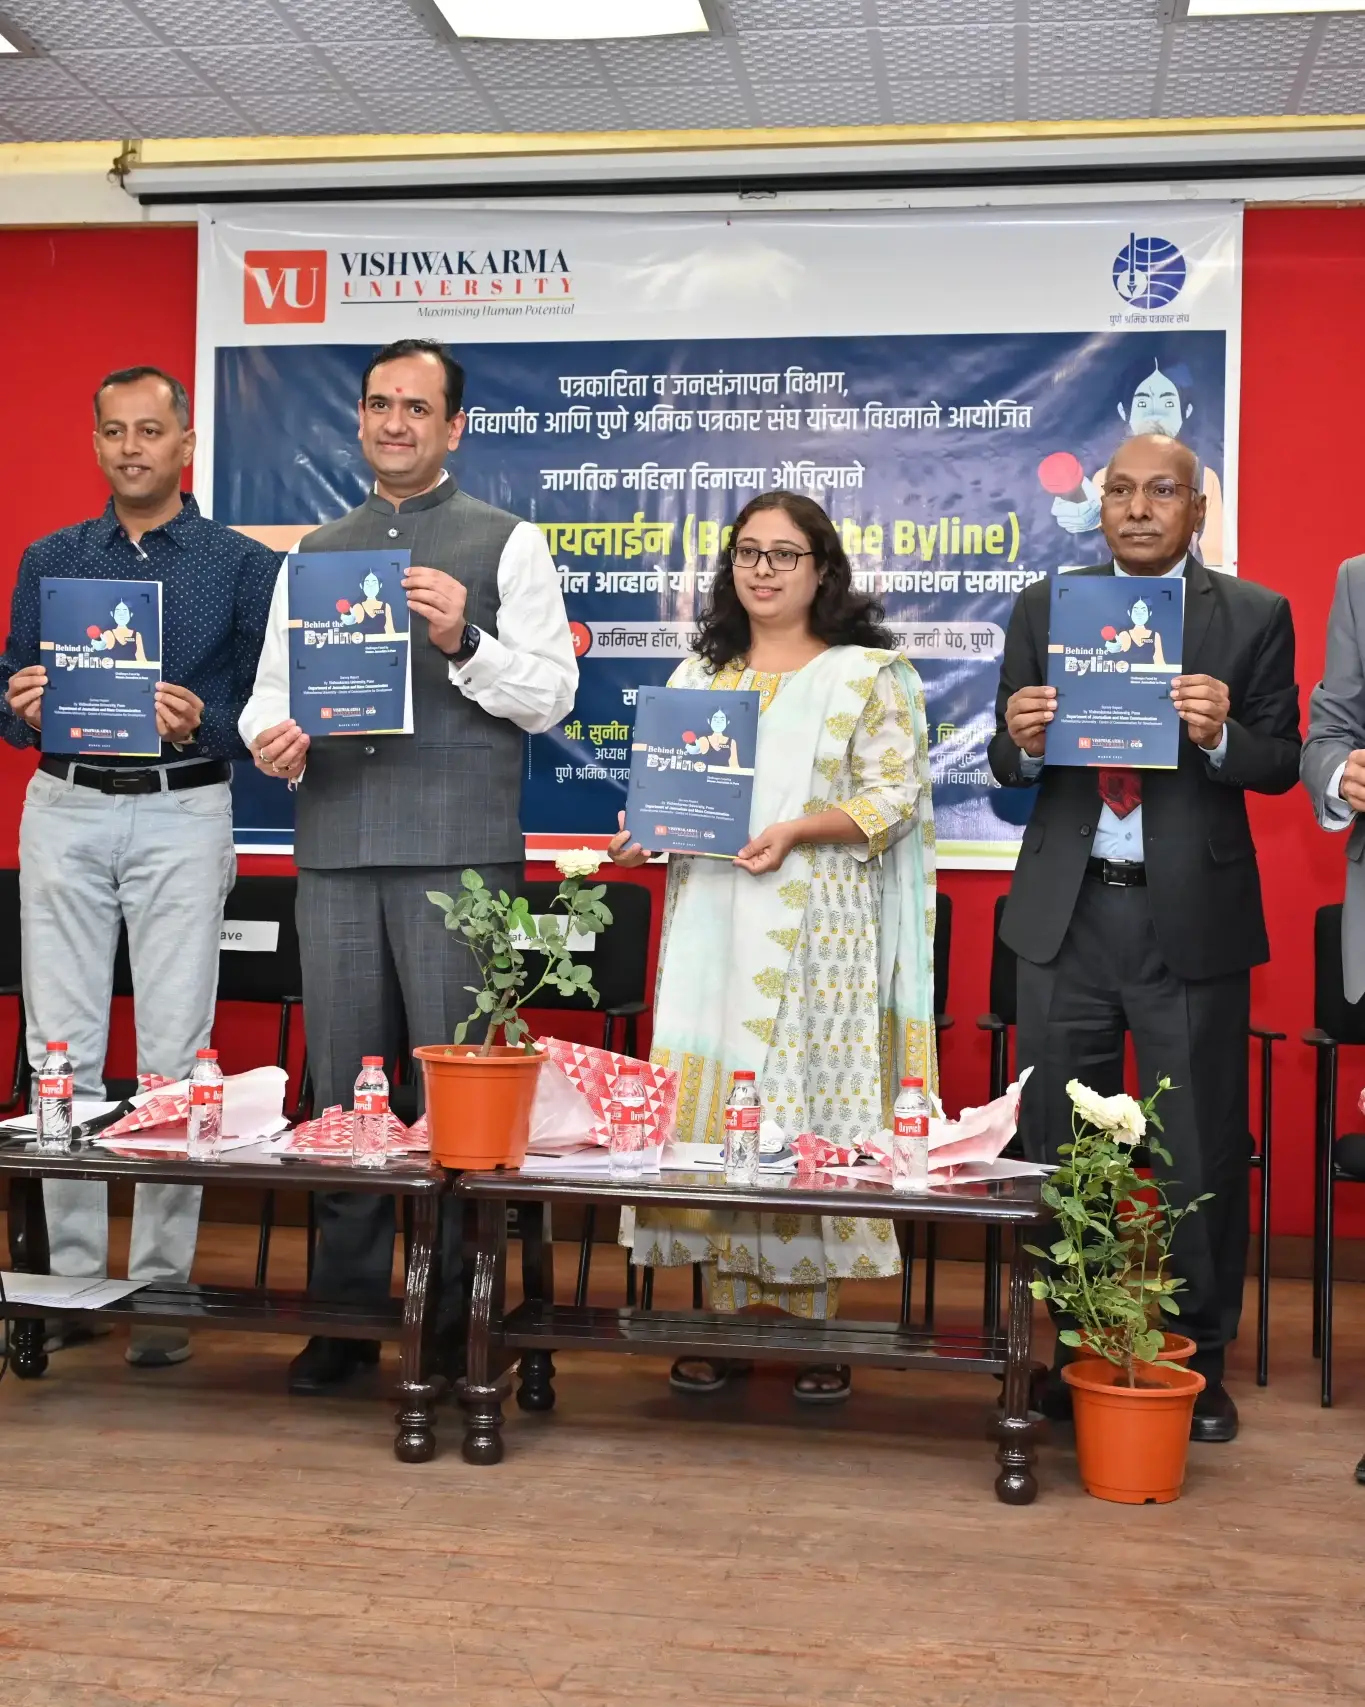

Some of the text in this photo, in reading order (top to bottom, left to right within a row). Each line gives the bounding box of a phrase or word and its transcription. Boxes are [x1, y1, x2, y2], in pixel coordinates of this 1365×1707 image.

[340, 248, 571, 277] VISHWAKARMA
[247, 267, 319, 309] VU
[344, 278, 574, 298] UNIVERSITY
[417, 303, 574, 319] Maximising Human Potential
[559, 366, 848, 397] पत्रकारिता व जनसंज्ञापन विभाग,
[467, 399, 1034, 440] विद्यापीठ आणि पुणे श्रमिक पत्रकार संघ यांच्या विद्यमाने आयोजित
[540, 460, 865, 491] जागतिक महिला दिनाच्या औचित्याने
[537, 512, 674, 559] ायलाईन
[894, 512, 1020, 563] Byline)
[595, 565, 666, 594] आव्हाने
[304, 620, 344, 628] Behind the
[55, 644, 81, 652] Behind
[304, 628, 364, 648] Byline
[597, 628, 649, 648] कमिन्स
[651, 629, 682, 650] हॉल,
[913, 628, 941, 648] नवी
[944, 628, 967, 650] पेठ,
[970, 628, 995, 653] पुणे
[1065, 647, 1093, 655] Behind
[55, 653, 115, 671] Byline
[1065, 656, 1129, 675] Byline
[564, 720, 585, 741] श्री.
[588, 720, 629, 746] सुनीत
[595, 747, 627, 761] अध्यक्ष
[648, 745, 688, 756] Behind the
[555, 763, 573, 784] पुणे
[575, 763, 608, 780] श्रमिक
[220, 931, 243, 941] ave
